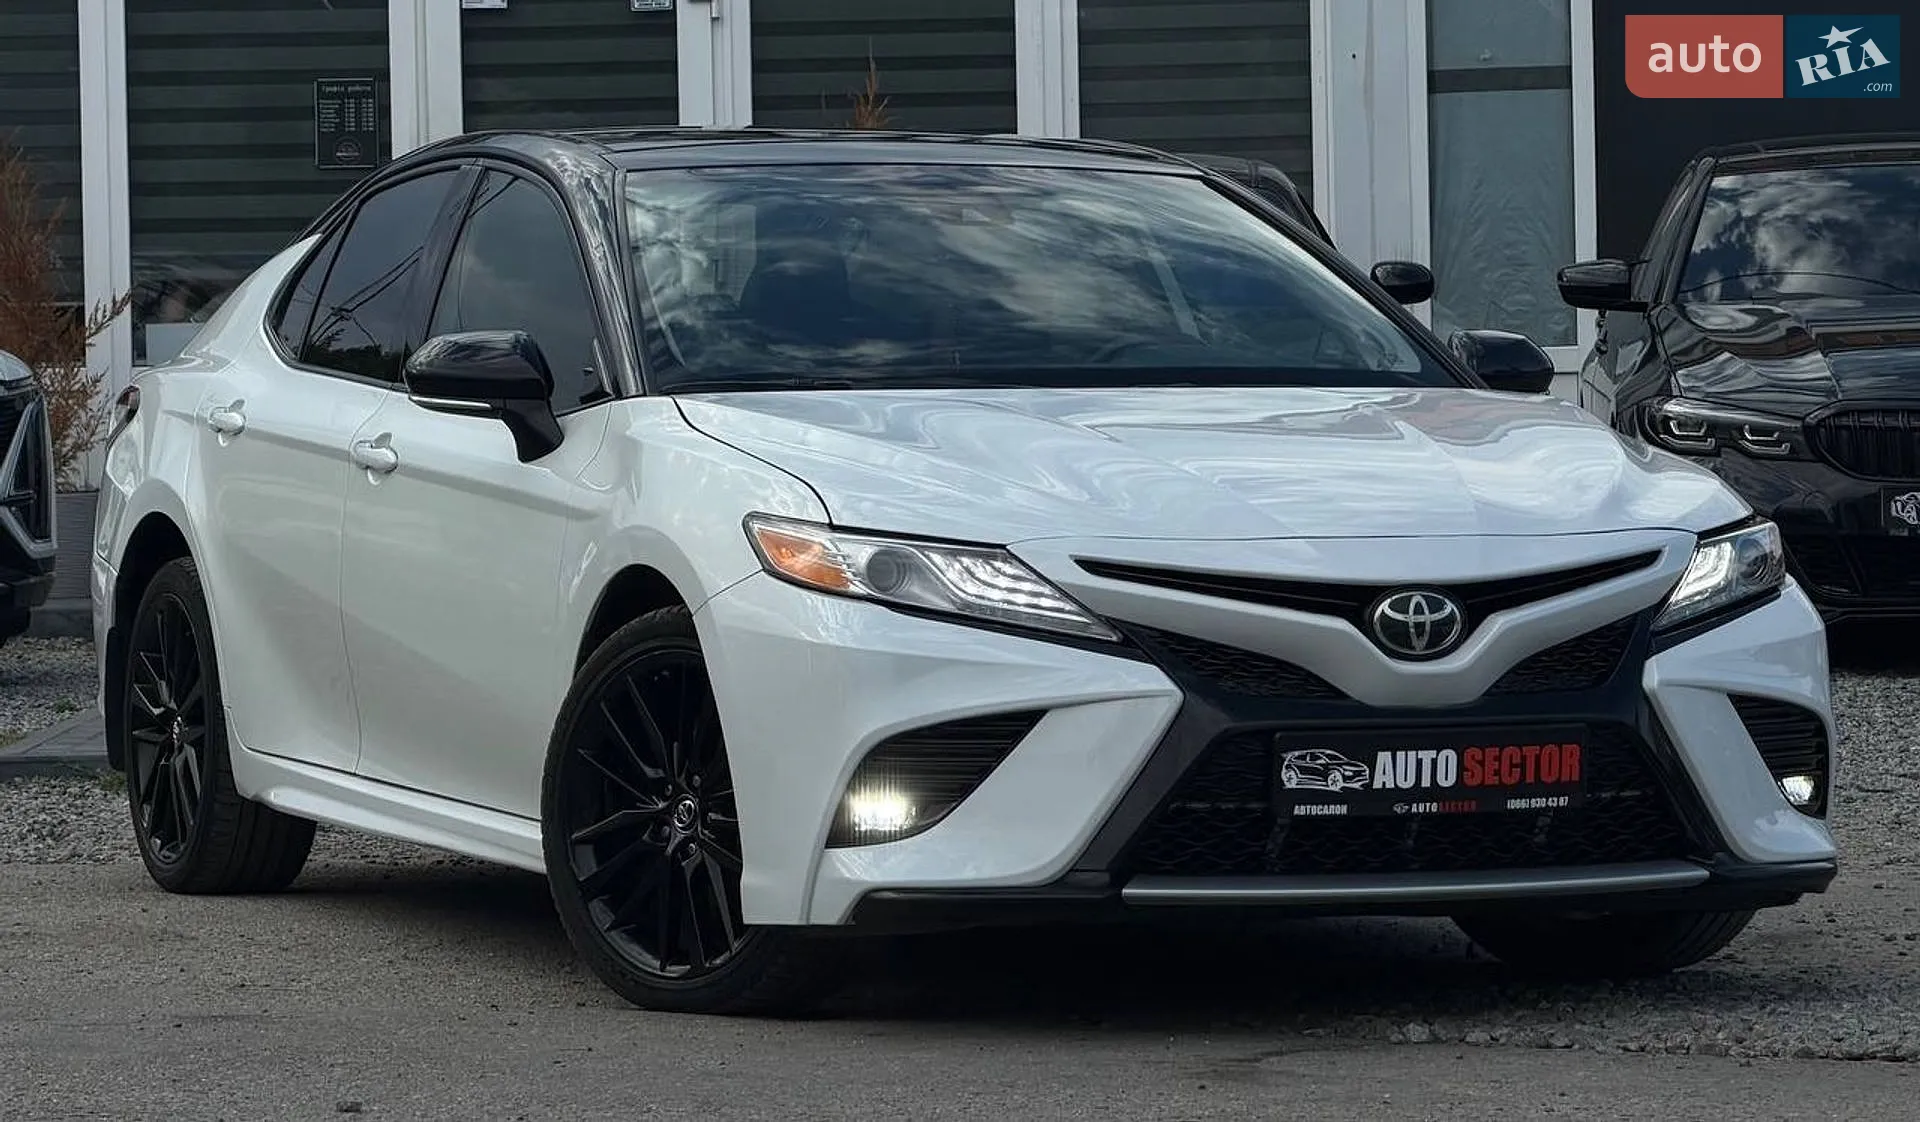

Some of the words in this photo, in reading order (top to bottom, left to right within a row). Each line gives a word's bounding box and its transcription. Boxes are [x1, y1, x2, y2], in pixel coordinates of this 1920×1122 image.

[1372, 748, 1458, 789] AUTO
[1463, 744, 1581, 788] SECTOR
[1293, 804, 1348, 816] АВТОСАЛОН
[1411, 802, 1438, 813] AUTO
